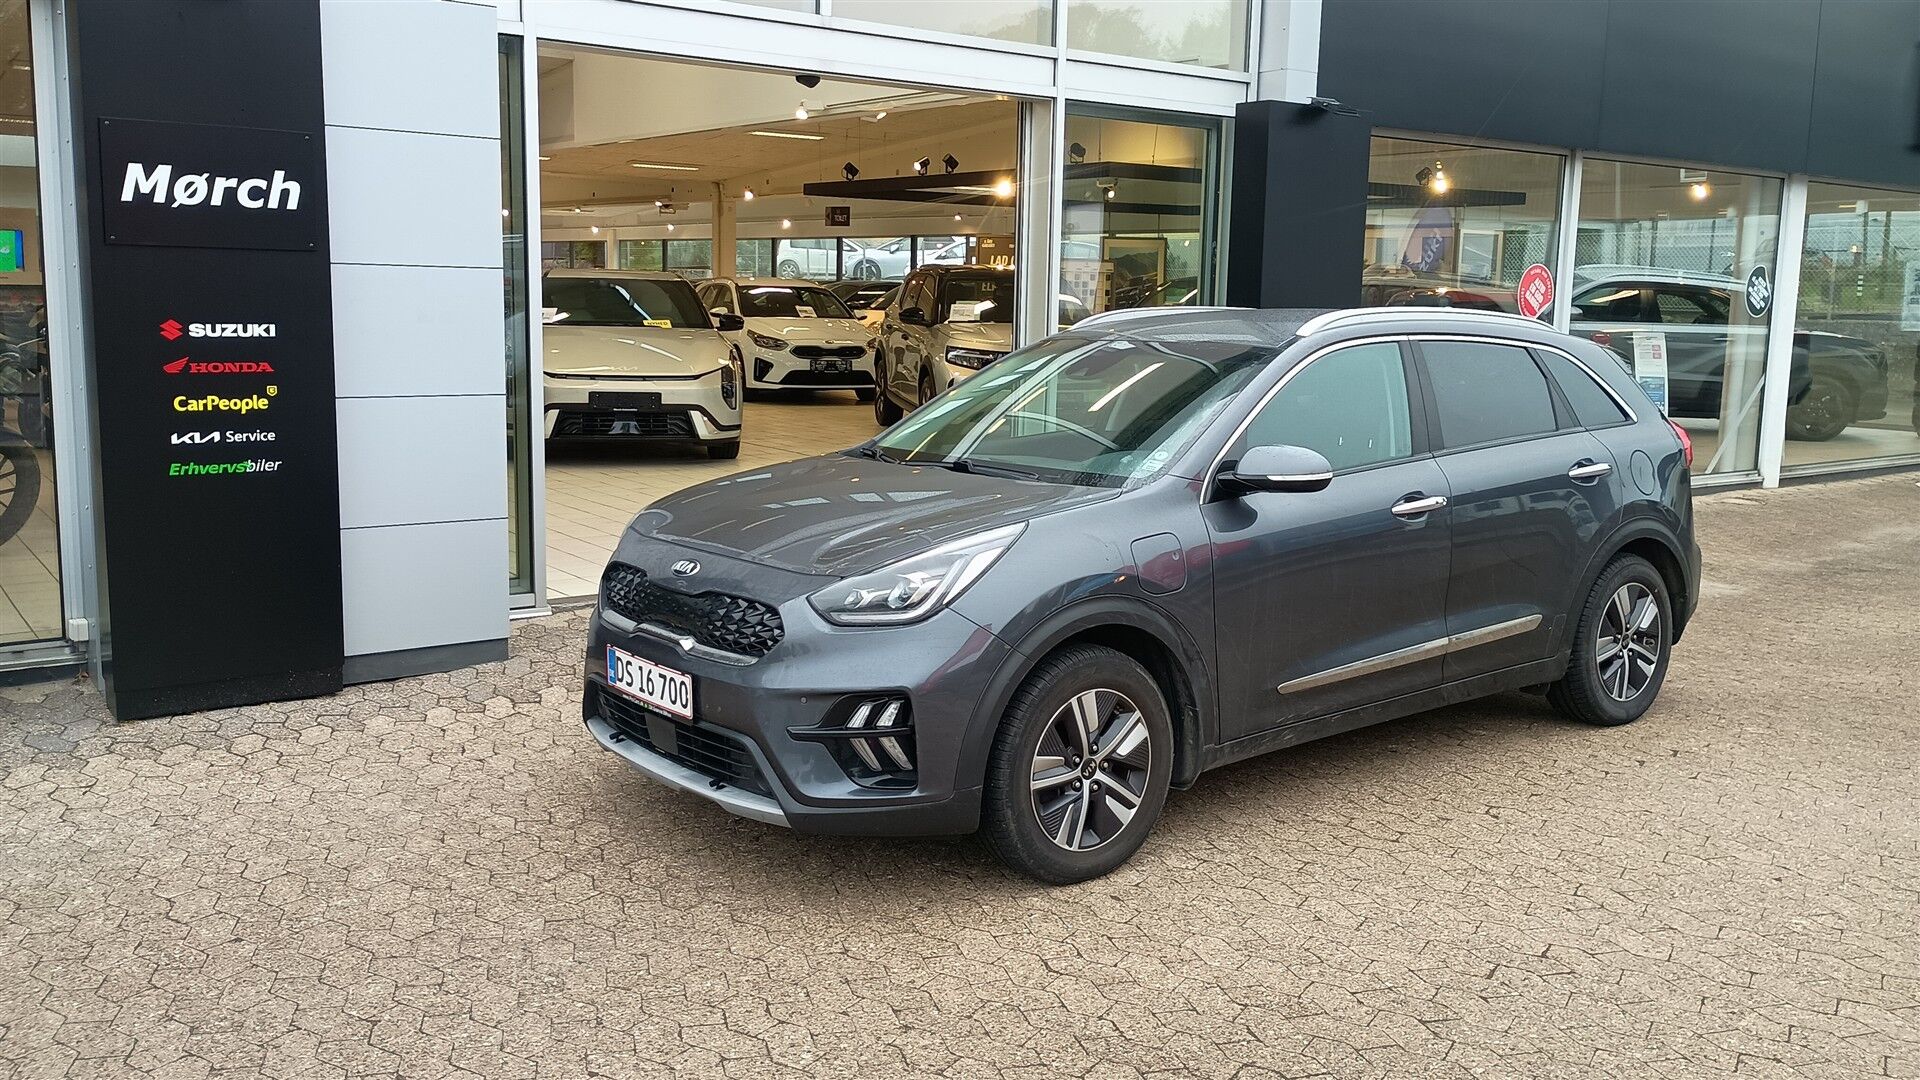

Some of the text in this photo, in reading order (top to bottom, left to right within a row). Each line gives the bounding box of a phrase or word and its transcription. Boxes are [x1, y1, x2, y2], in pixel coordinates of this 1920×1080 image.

[121, 162, 301, 210] Mørch
[990, 255, 1009, 266] LAD
[188, 323, 276, 337] SUZUKI
[189, 362, 275, 373] HONDA
[173, 394, 269, 414] CarPeople
[170, 429, 276, 445] KIA Service
[169, 459, 283, 476] Erhvervsbiler
[673, 560, 696, 574] KIA
[616, 656, 634, 687] DS
[638, 665, 655, 697] 16
[658, 672, 689, 710] 700
[1083, 760, 1096, 777] KIA
